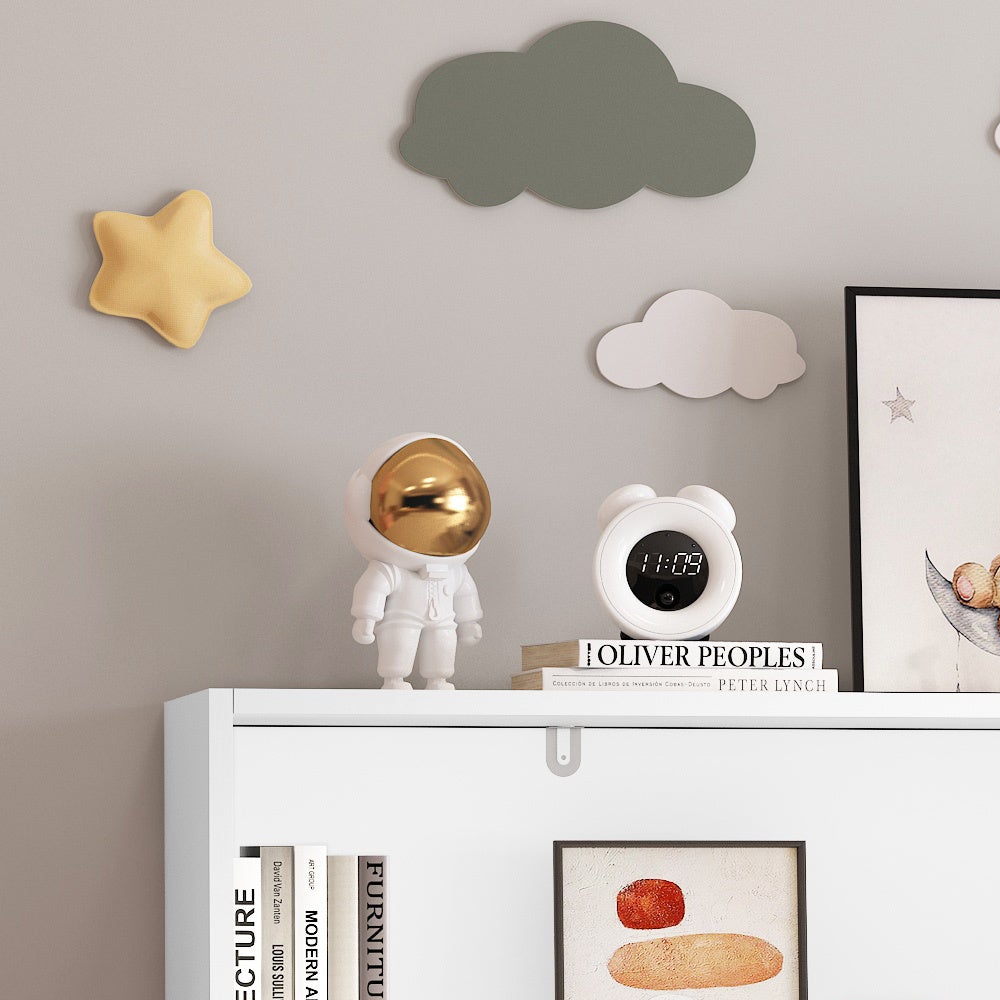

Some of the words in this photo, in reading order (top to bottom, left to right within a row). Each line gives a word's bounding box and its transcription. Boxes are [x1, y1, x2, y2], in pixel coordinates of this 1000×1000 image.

[641, 552, 703, 576] 11:09
[597, 644, 690, 667] OLIVER
[698, 645, 806, 668] PEOPLES
[718, 678, 769, 692] PETER
[774, 679, 826, 692] LYNCH
[273, 861, 283, 882] David
[308, 858, 316, 870] ART
[273, 882, 283, 897] Van
[308, 871, 316, 890] GROUP
[273, 898, 283, 925] Zanten
[305, 910, 318, 981] MODERN
[271, 944, 284, 971] LOUIS
